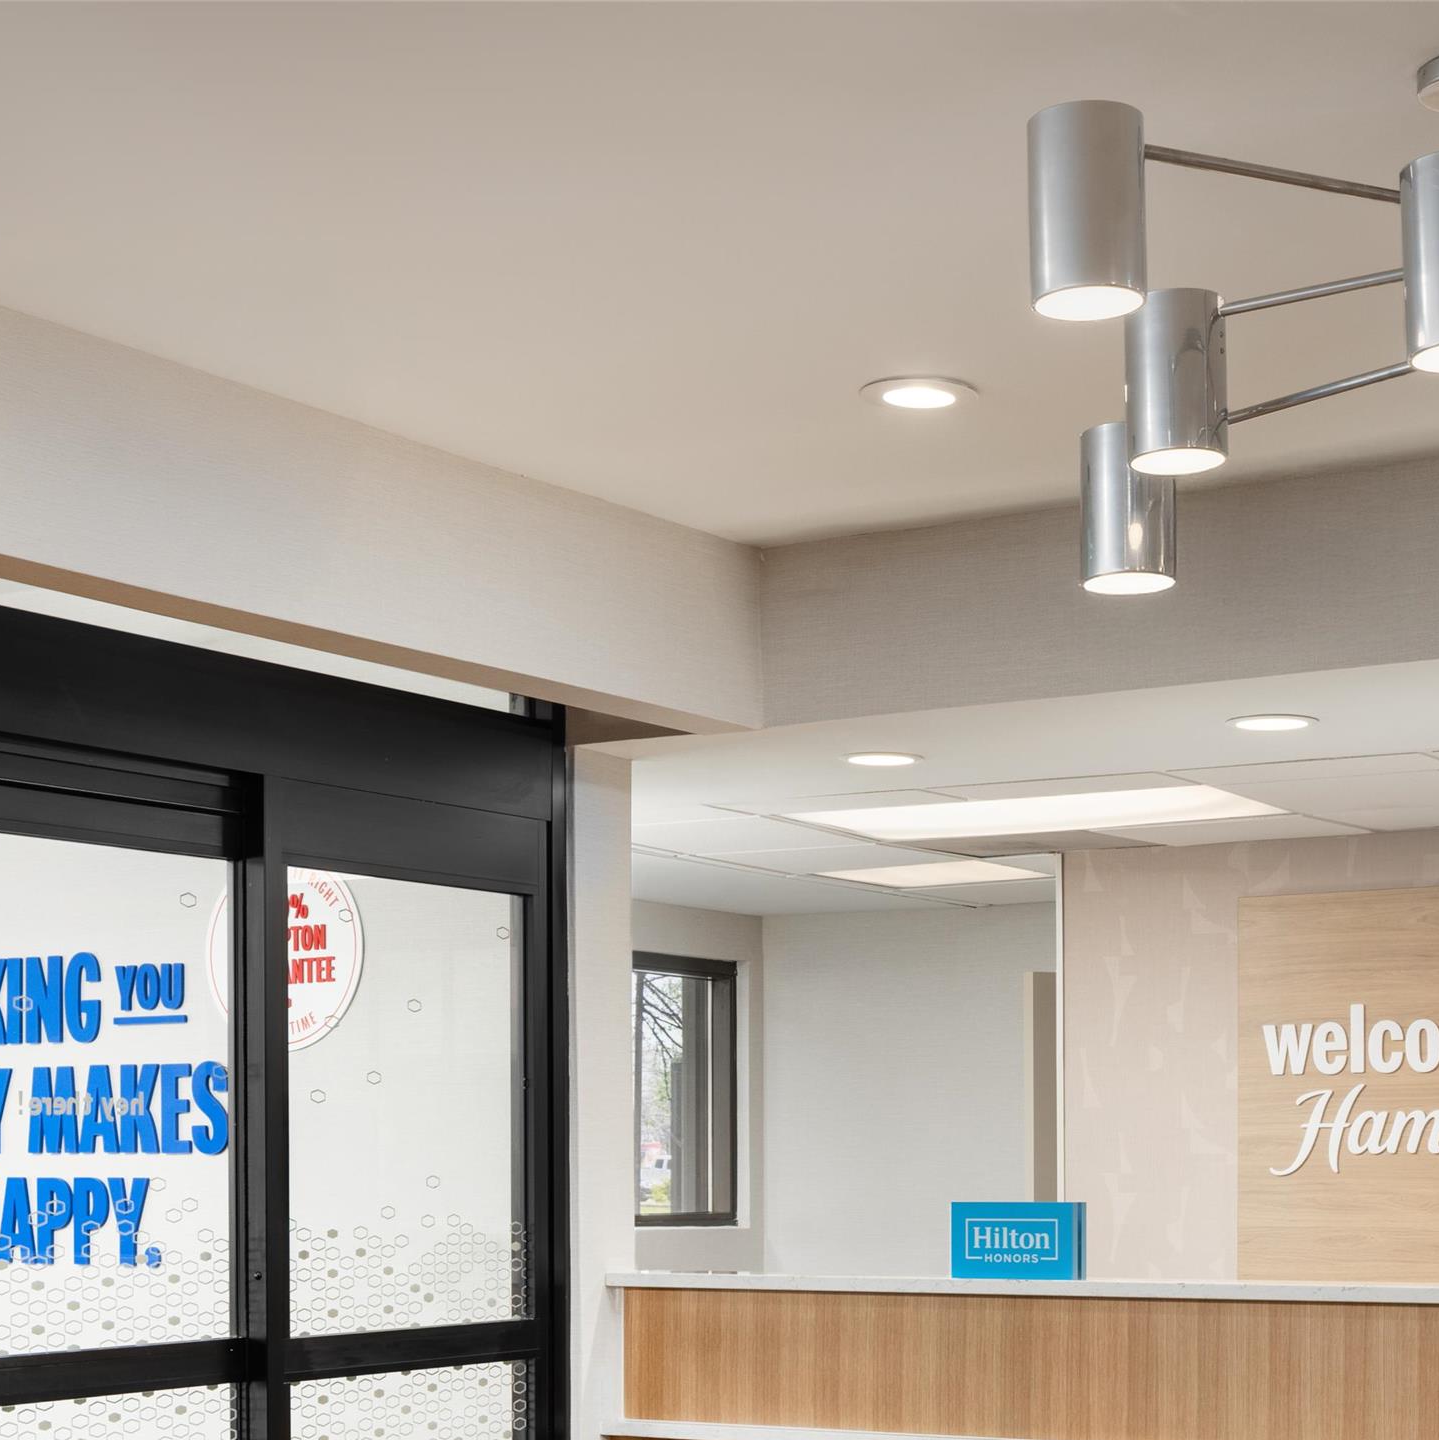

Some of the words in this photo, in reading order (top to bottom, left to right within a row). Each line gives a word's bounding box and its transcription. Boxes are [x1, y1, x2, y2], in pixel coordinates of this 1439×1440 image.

[115, 963, 185, 1012] YOU
[290, 1011, 317, 1035] TIME
[28, 1061, 229, 1156] MAKES
[973, 1226, 1050, 1249] Hilton
[984, 1253, 1039, 1264] HONORS
